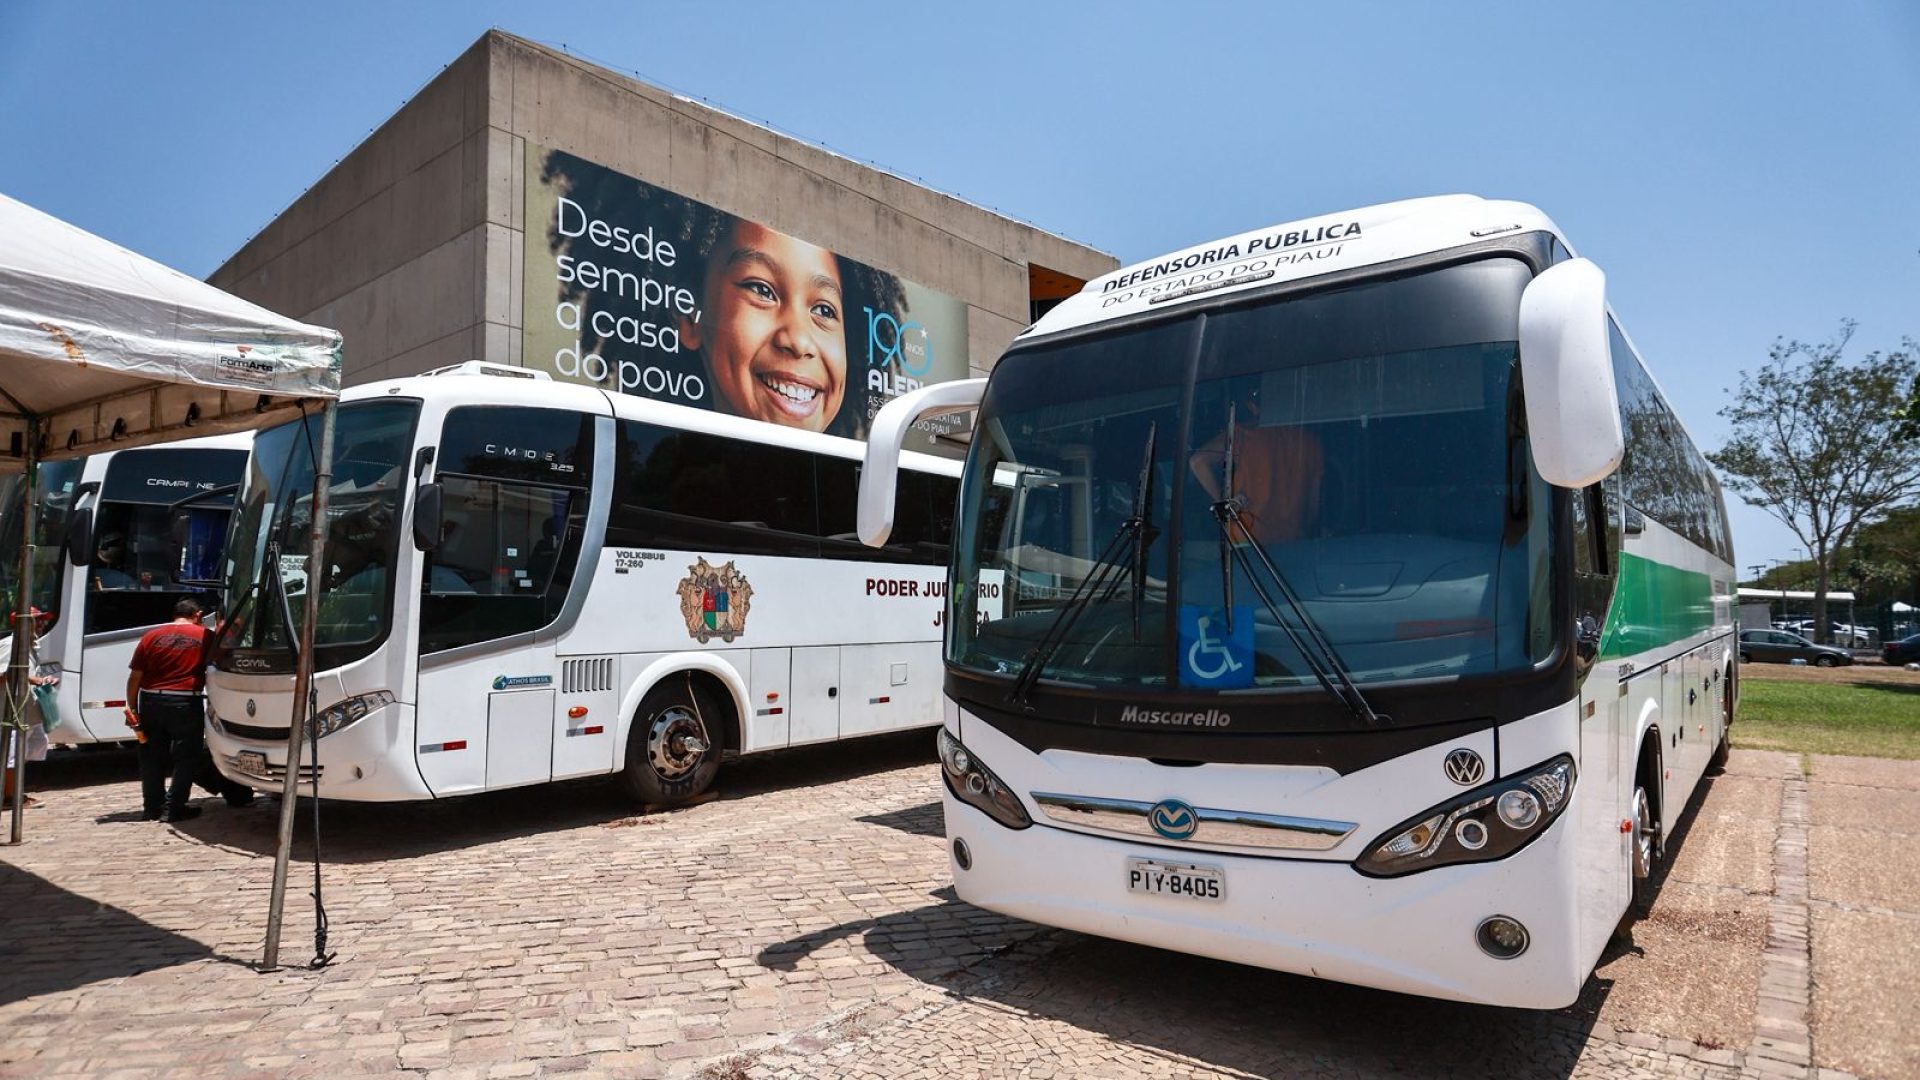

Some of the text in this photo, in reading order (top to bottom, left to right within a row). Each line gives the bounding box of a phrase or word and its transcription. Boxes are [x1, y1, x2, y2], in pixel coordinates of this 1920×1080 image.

[558, 197, 677, 267] Desde
[1103, 221, 1362, 293] DEFENSORIA PÚBLICA
[556, 254, 702, 324] sempre,
[1102, 244, 1344, 309] DO ESTADO DO PIAUÍ
[556, 301, 679, 354] a casa
[863, 306, 933, 377] 190
[905, 341, 924, 356] ANOS
[555, 340, 704, 400] do povo
[615, 559, 644, 569] 17-260
[616, 550, 666, 561] VOLKSBUS
[866, 578, 919, 597] PODER
[235, 659, 271, 668] COMIL
[508, 678, 528, 686] ATHOS
[1121, 705, 1231, 727] Mascarello
